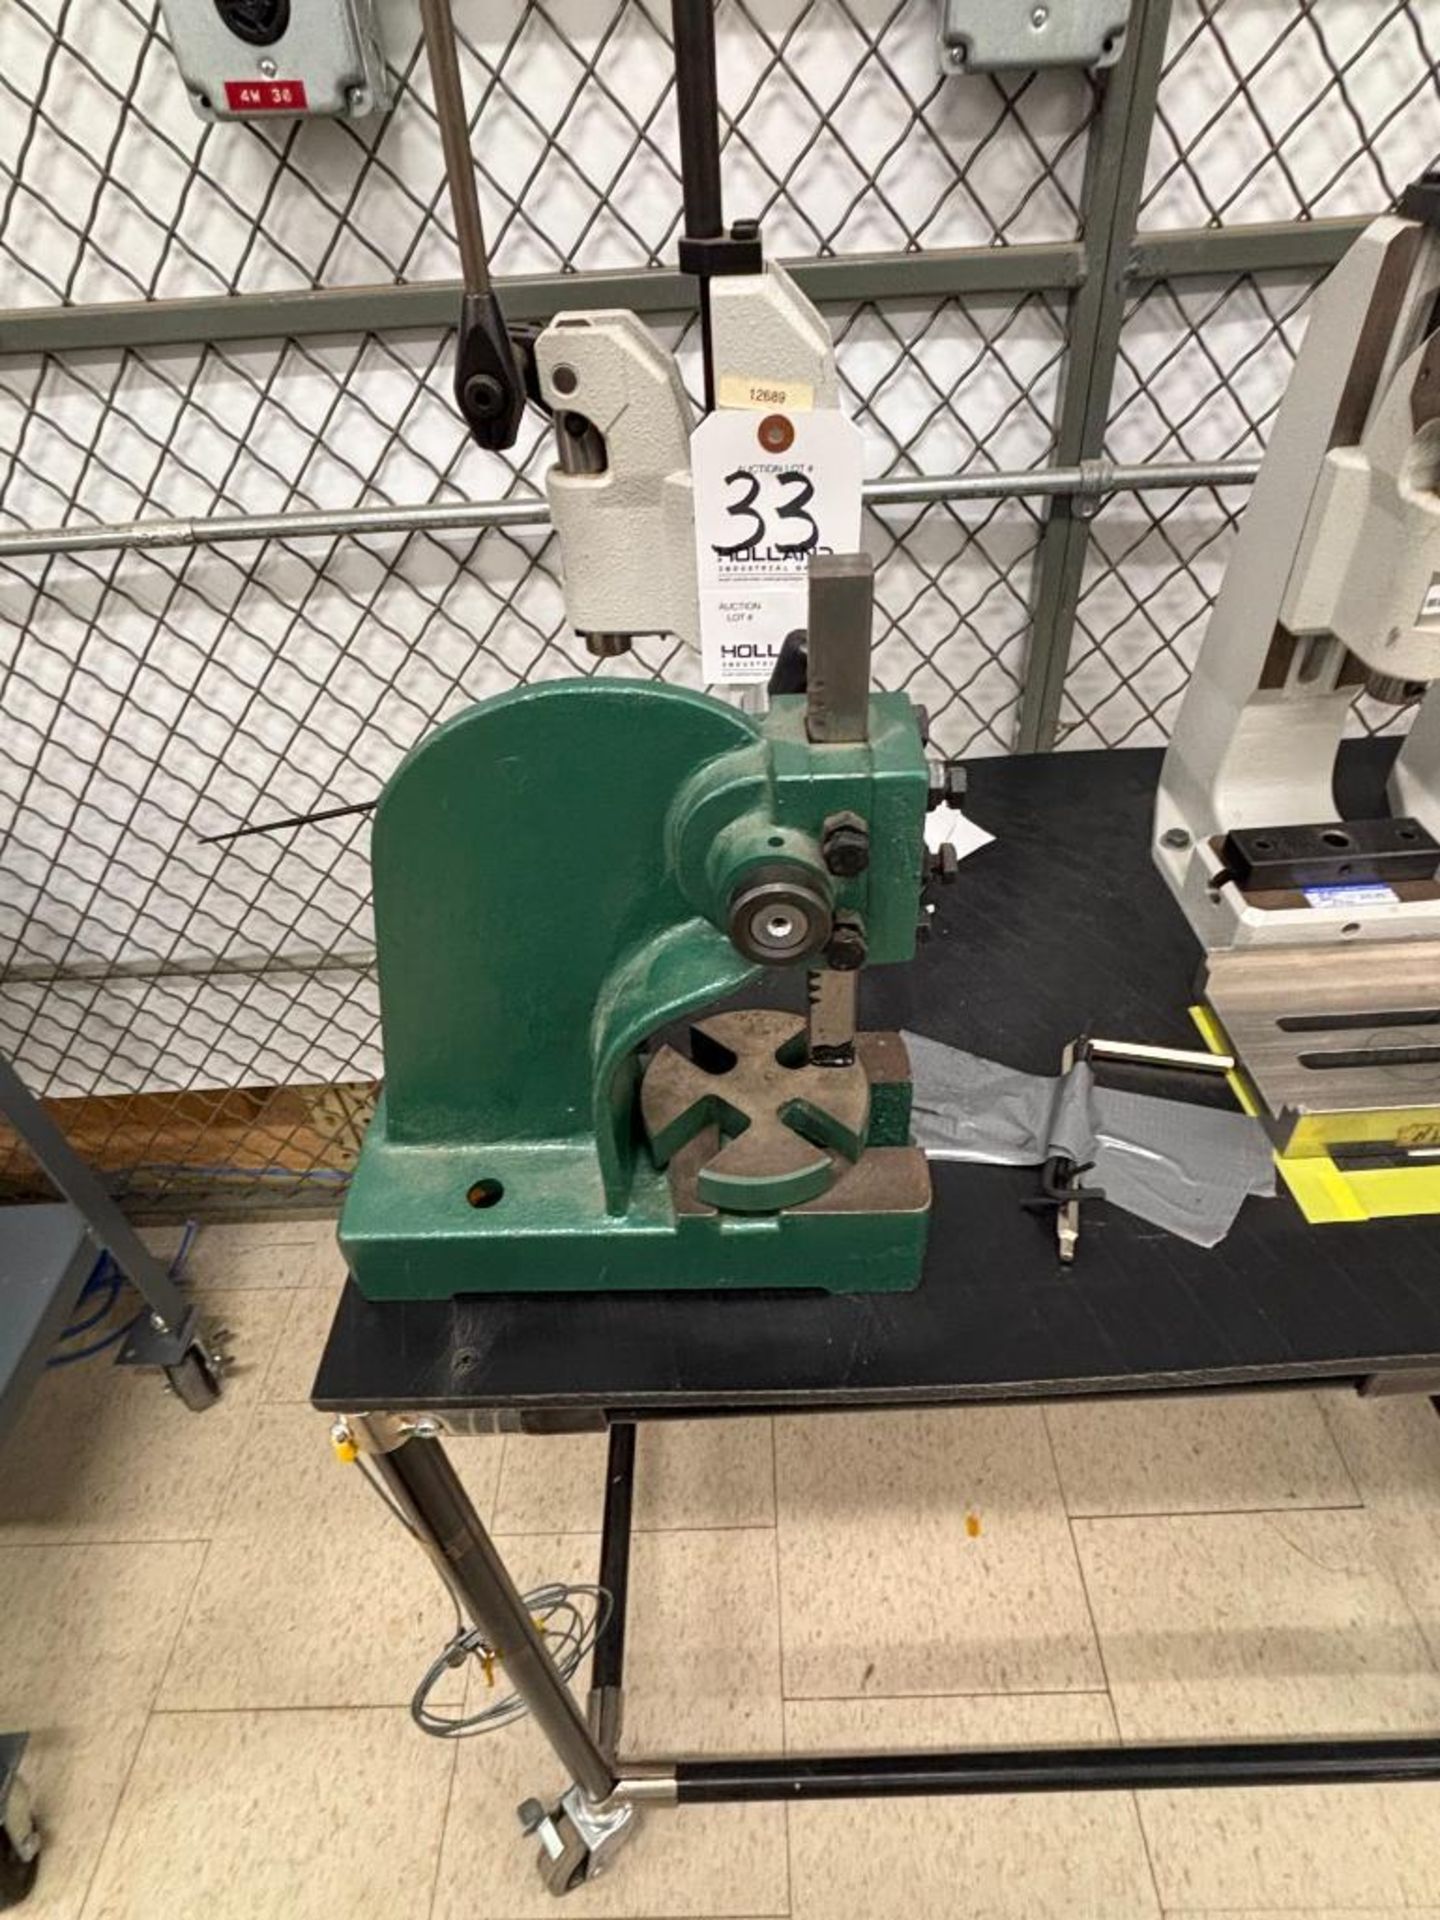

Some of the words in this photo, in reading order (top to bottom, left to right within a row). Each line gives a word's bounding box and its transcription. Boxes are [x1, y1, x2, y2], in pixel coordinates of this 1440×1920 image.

[738, 464, 782, 474] AUCTION
[784, 464, 804, 473] LOT
[711, 470, 819, 557] 33
[718, 602, 761, 611] AUCTION
[726, 613, 745, 622] LOT
[720, 643, 781, 659] HOLL
[722, 660, 774, 668] INDUSTRI
